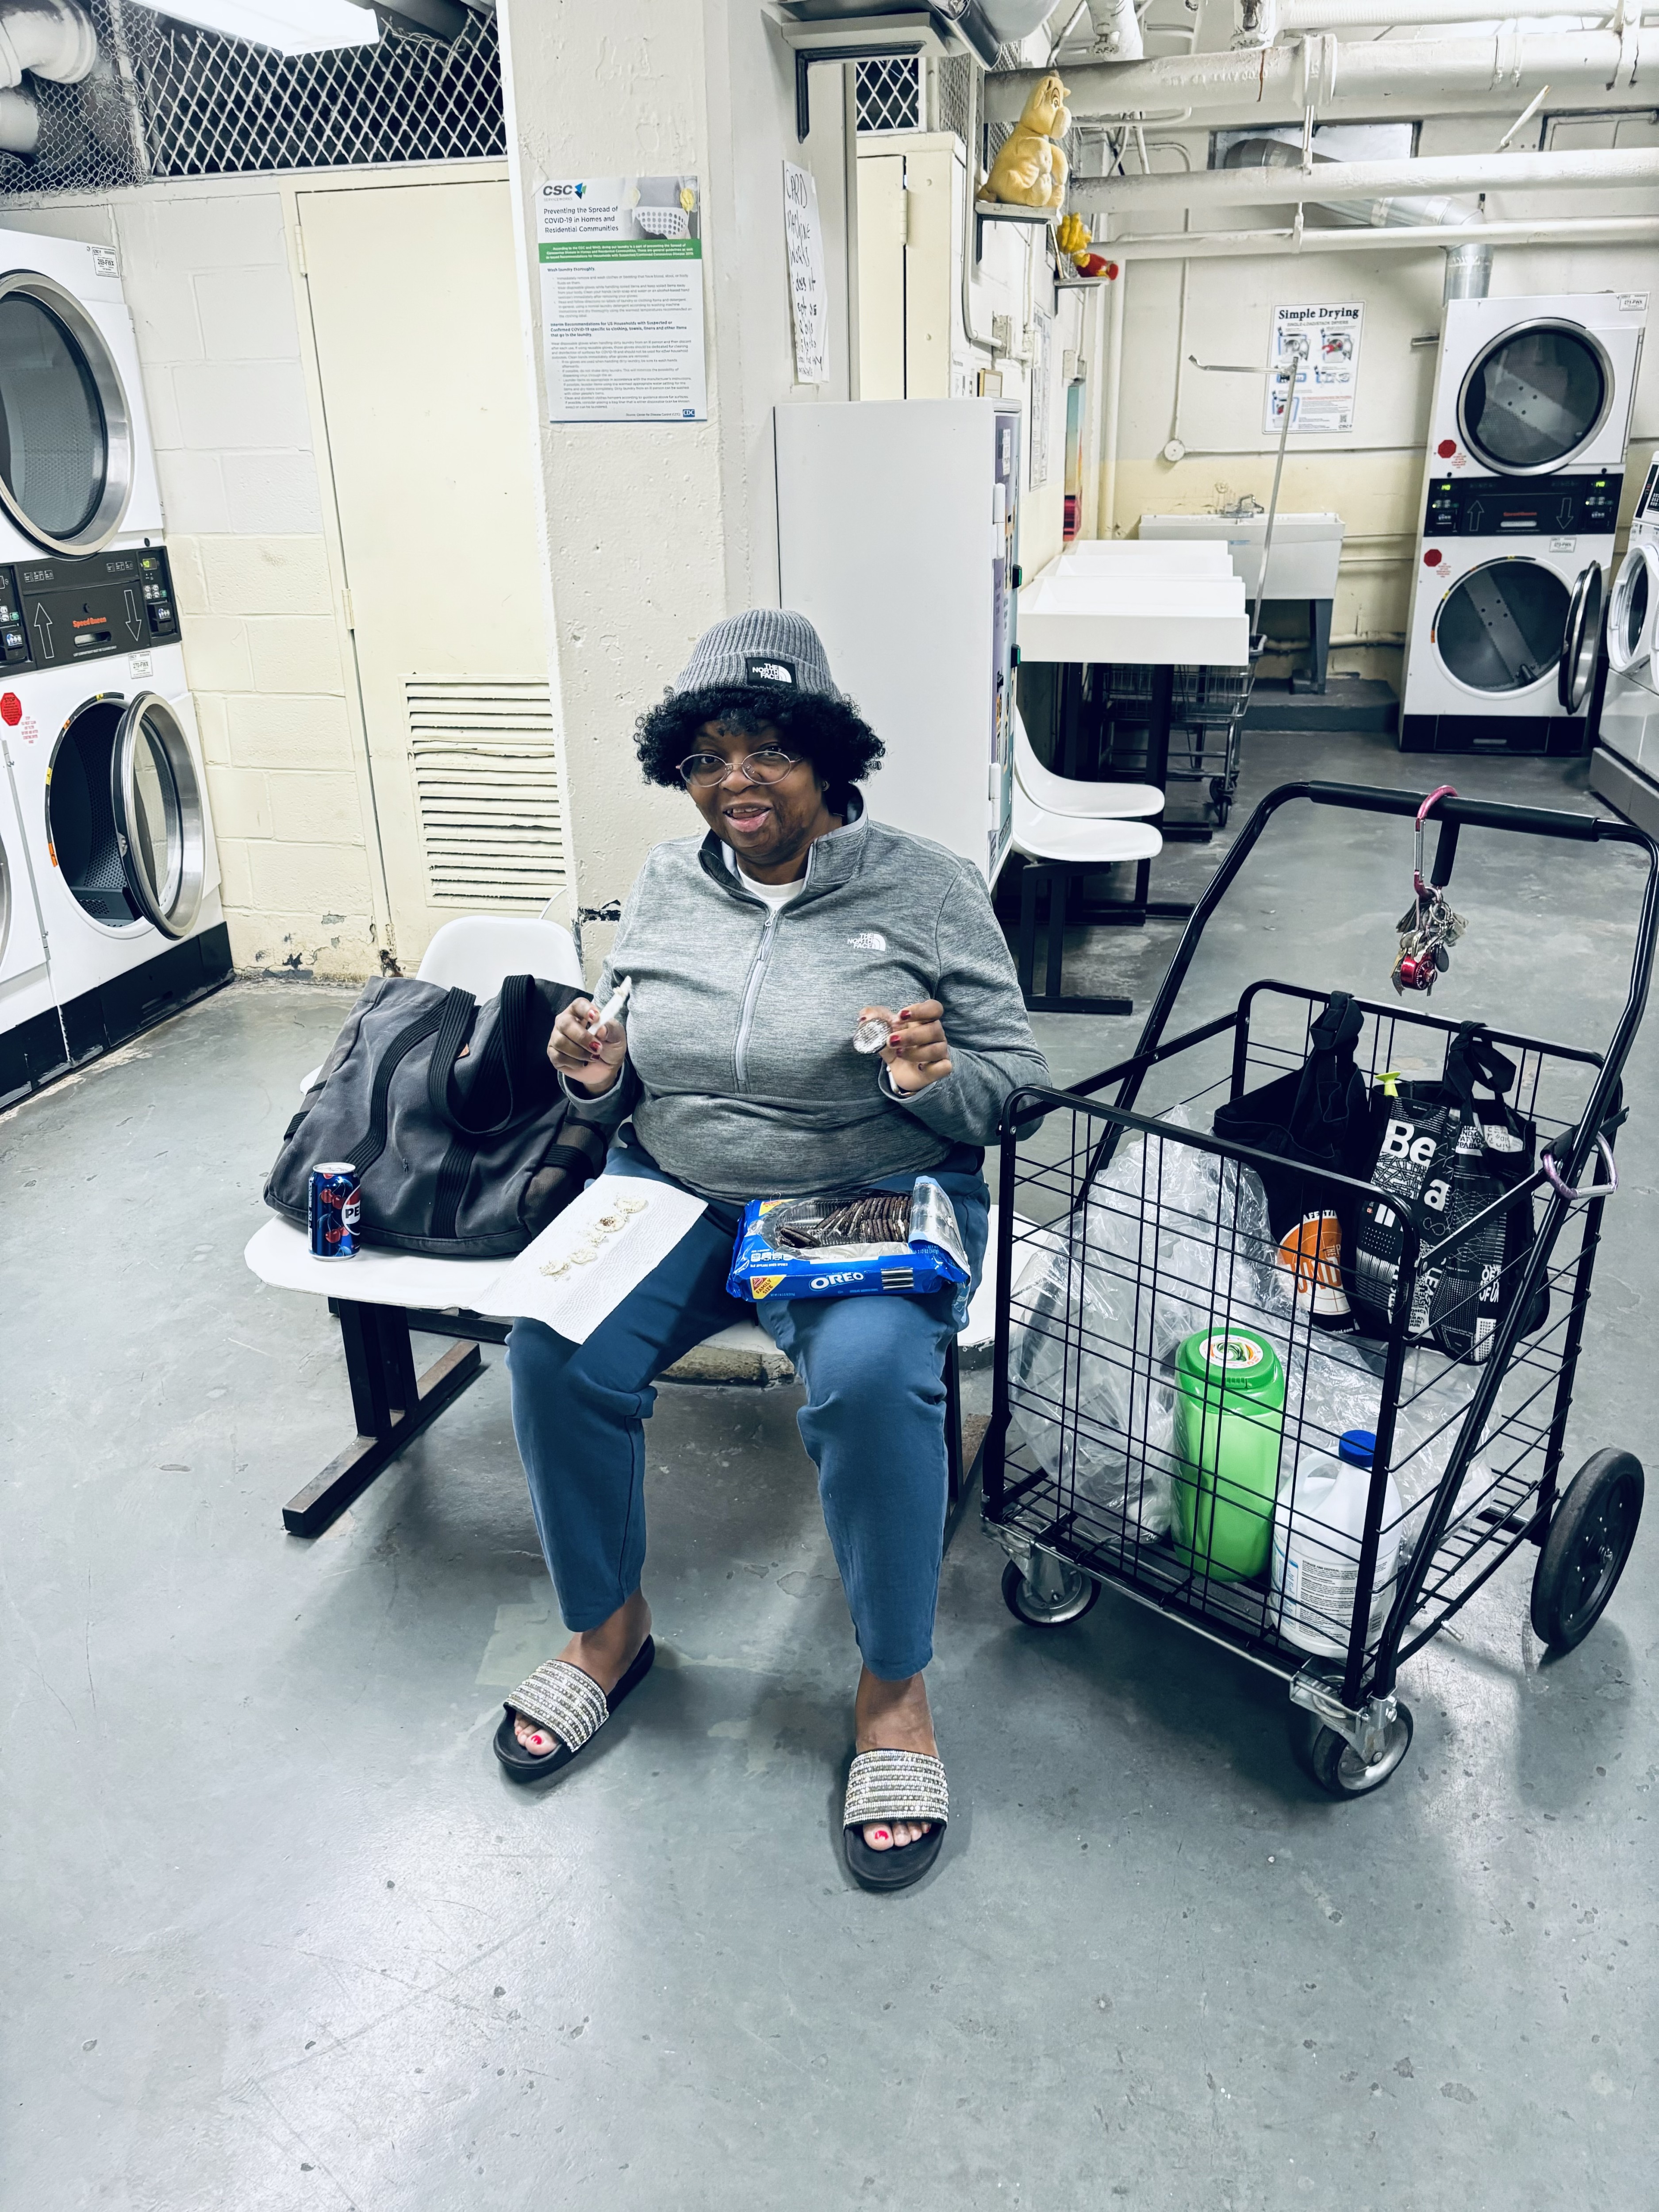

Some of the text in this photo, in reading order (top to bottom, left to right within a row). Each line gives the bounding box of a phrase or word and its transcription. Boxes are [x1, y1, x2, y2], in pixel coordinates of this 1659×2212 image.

[543, 185, 572, 196] CSC
[786, 169, 807, 208] CARD
[1279, 307, 1359, 321] Simple Drying
[73, 618, 90, 628] Speed
[753, 667, 779, 675] NORTH
[1379, 1118, 1437, 1169] Be
[1424, 1179, 1450, 1211] a
[756, 1278, 772, 1294] FAMILY
[810, 1272, 864, 1290] OREO
[763, 1284, 773, 1294] SIZE
